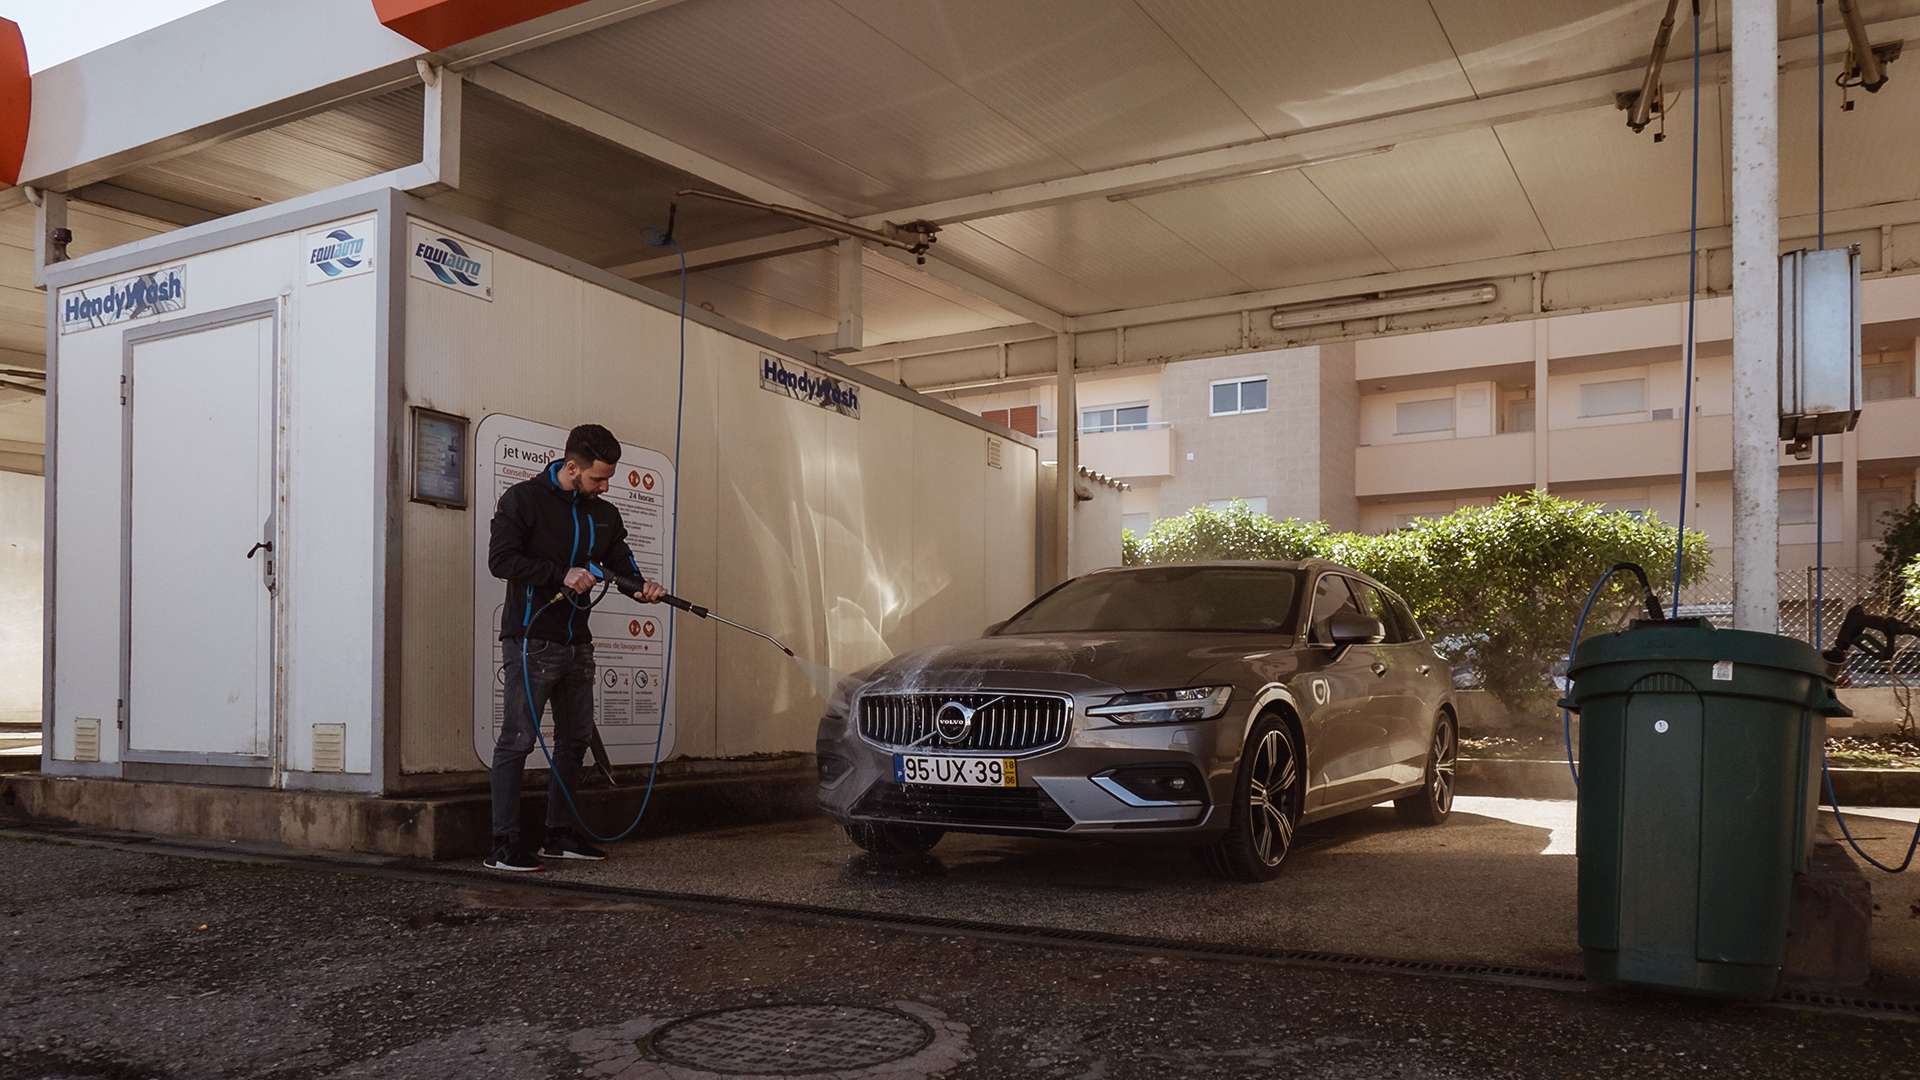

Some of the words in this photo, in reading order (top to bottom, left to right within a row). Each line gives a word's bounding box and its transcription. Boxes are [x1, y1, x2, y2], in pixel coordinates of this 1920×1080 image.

[65, 271, 181, 321] HandyWash
[764, 358, 858, 410] HandyWash
[503, 444, 519, 459] jet
[521, 450, 550, 464] wash
[1004, 761, 1014, 769] 18
